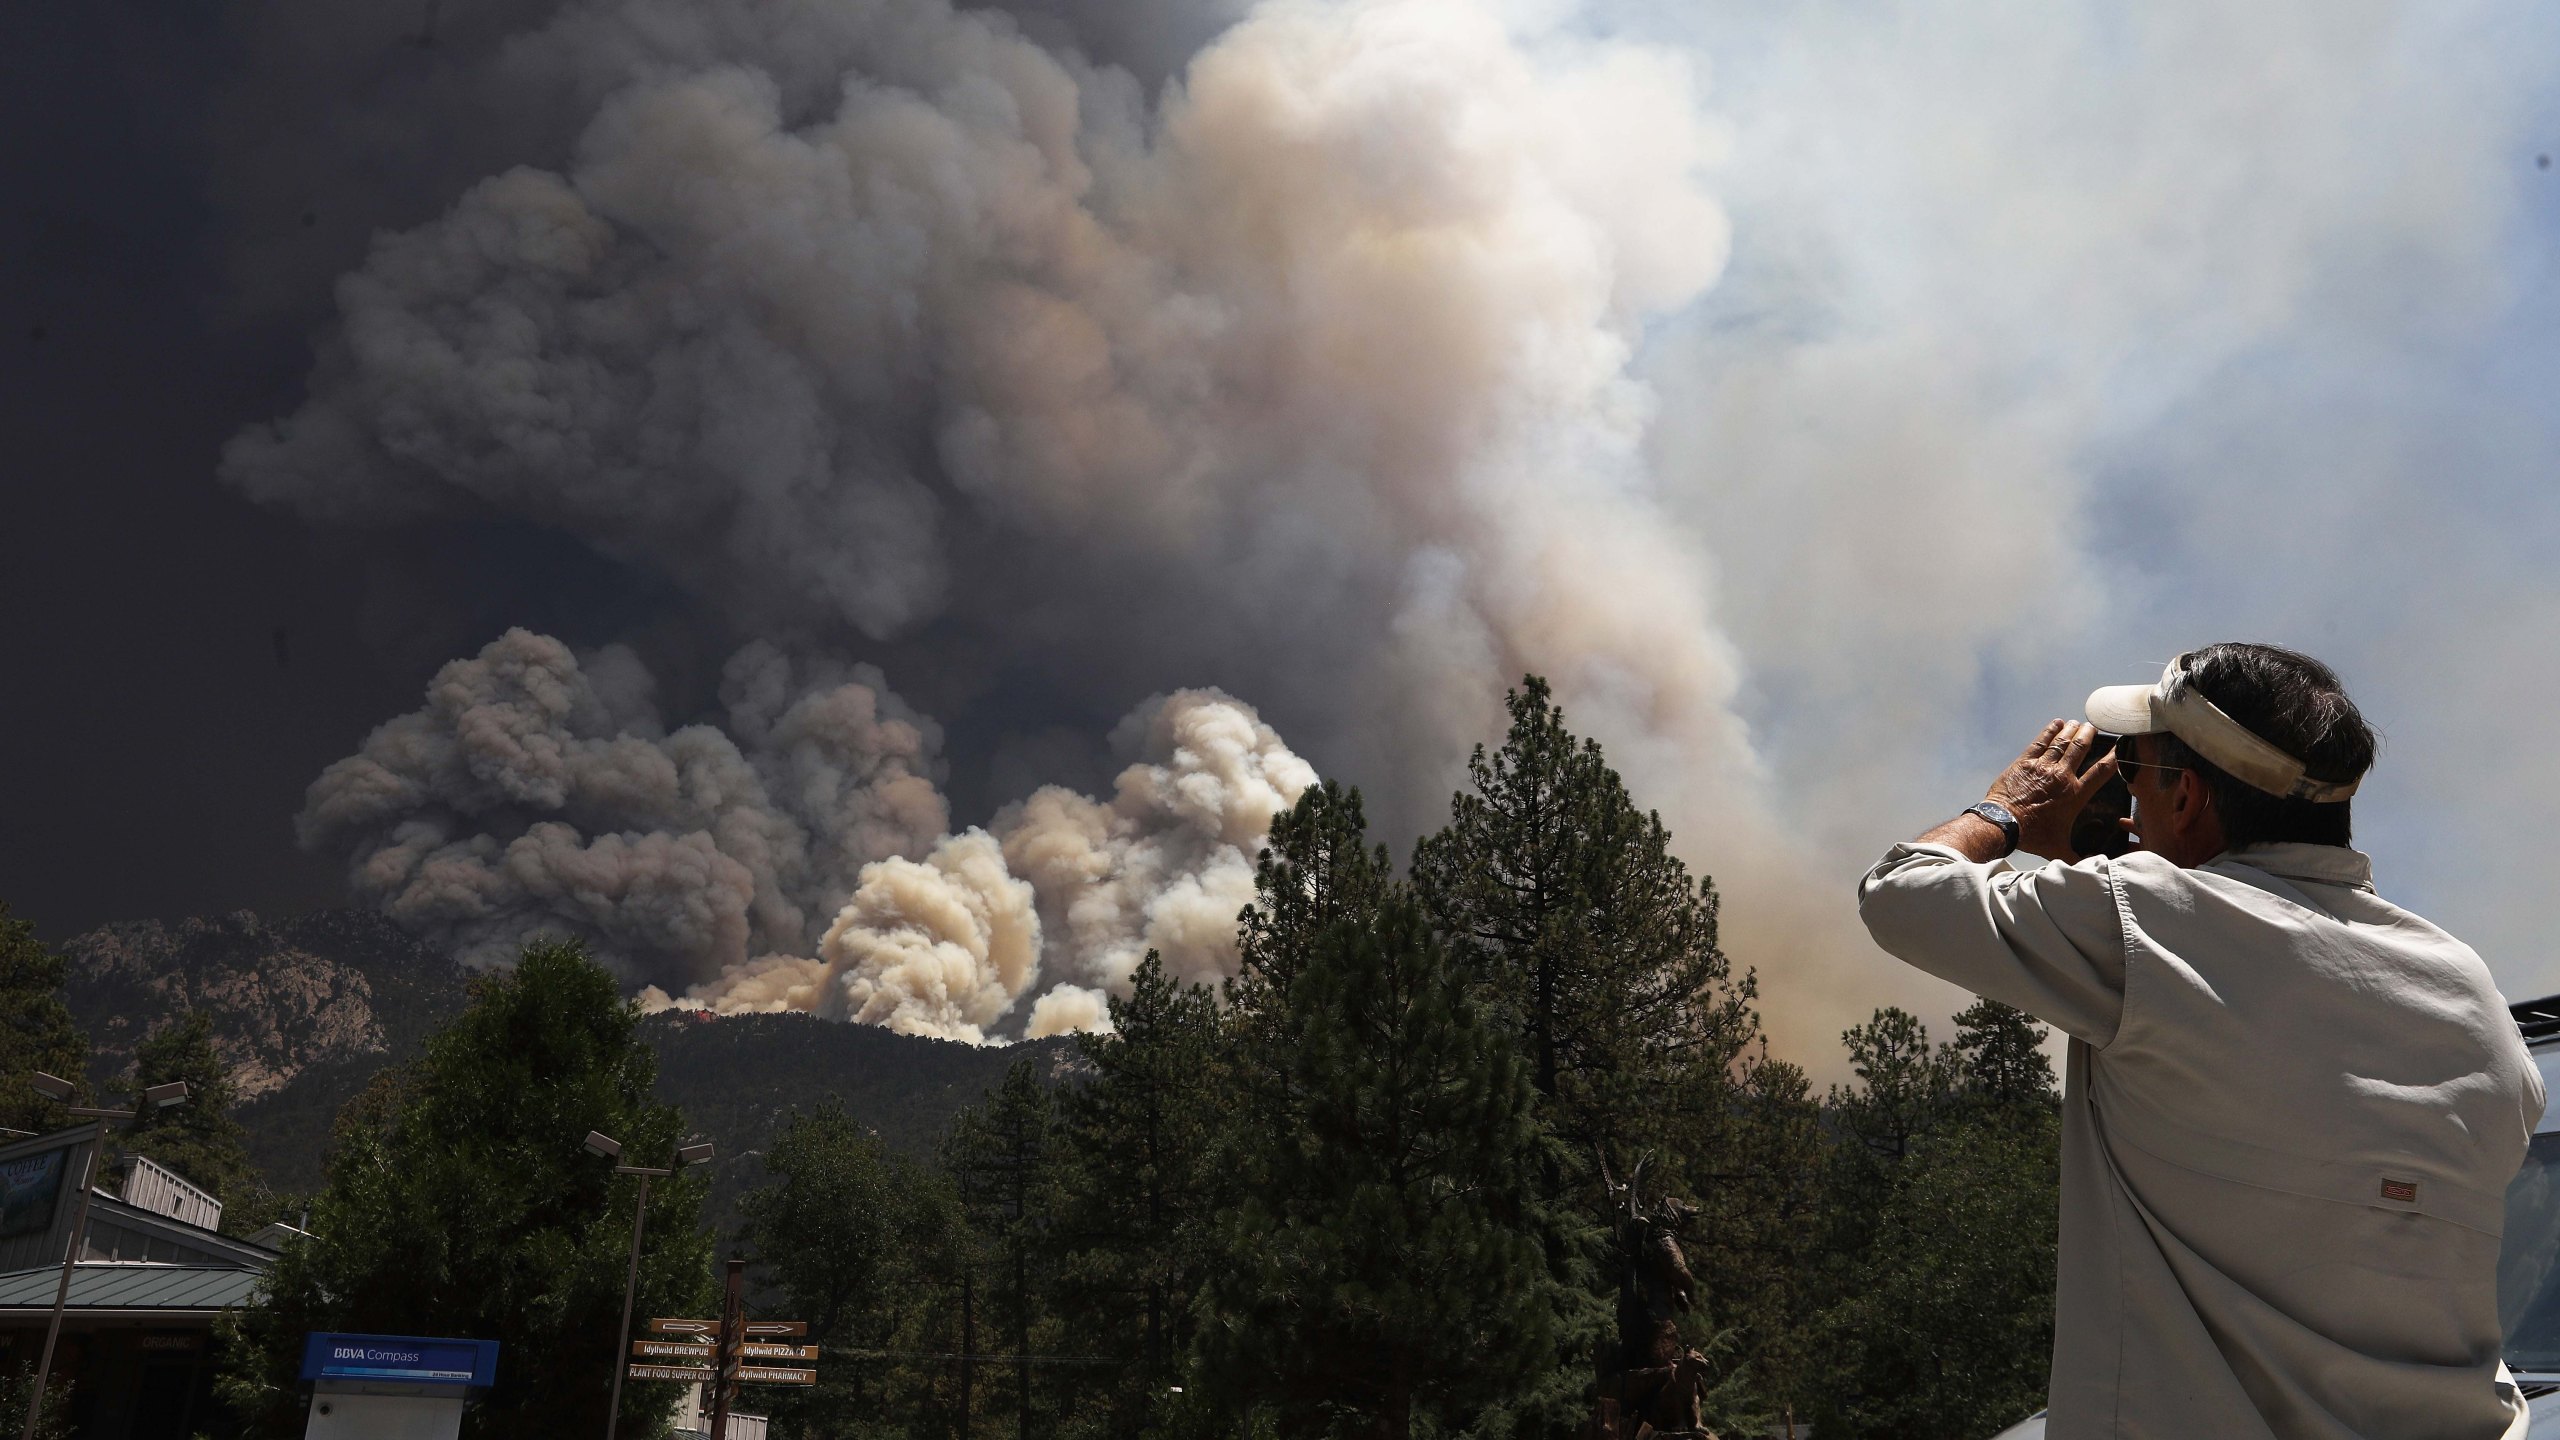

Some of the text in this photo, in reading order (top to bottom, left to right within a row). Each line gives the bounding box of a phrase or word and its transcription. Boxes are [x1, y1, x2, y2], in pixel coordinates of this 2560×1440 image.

[7, 1155, 48, 1177] COFFEE
[143, 1336, 192, 1349] ORGANIC
[334, 1347, 420, 1363] BBVA Compass
[644, 1344, 709, 1356] Idyllwild BREWPUB
[744, 1346, 773, 1356] Idyllwild
[774, 1347, 794, 1357] PIZZA
[629, 1367, 716, 1381] PLANT FOOD SUPPER CLUB
[738, 1370, 807, 1381] Idyllwild PHARMACY
